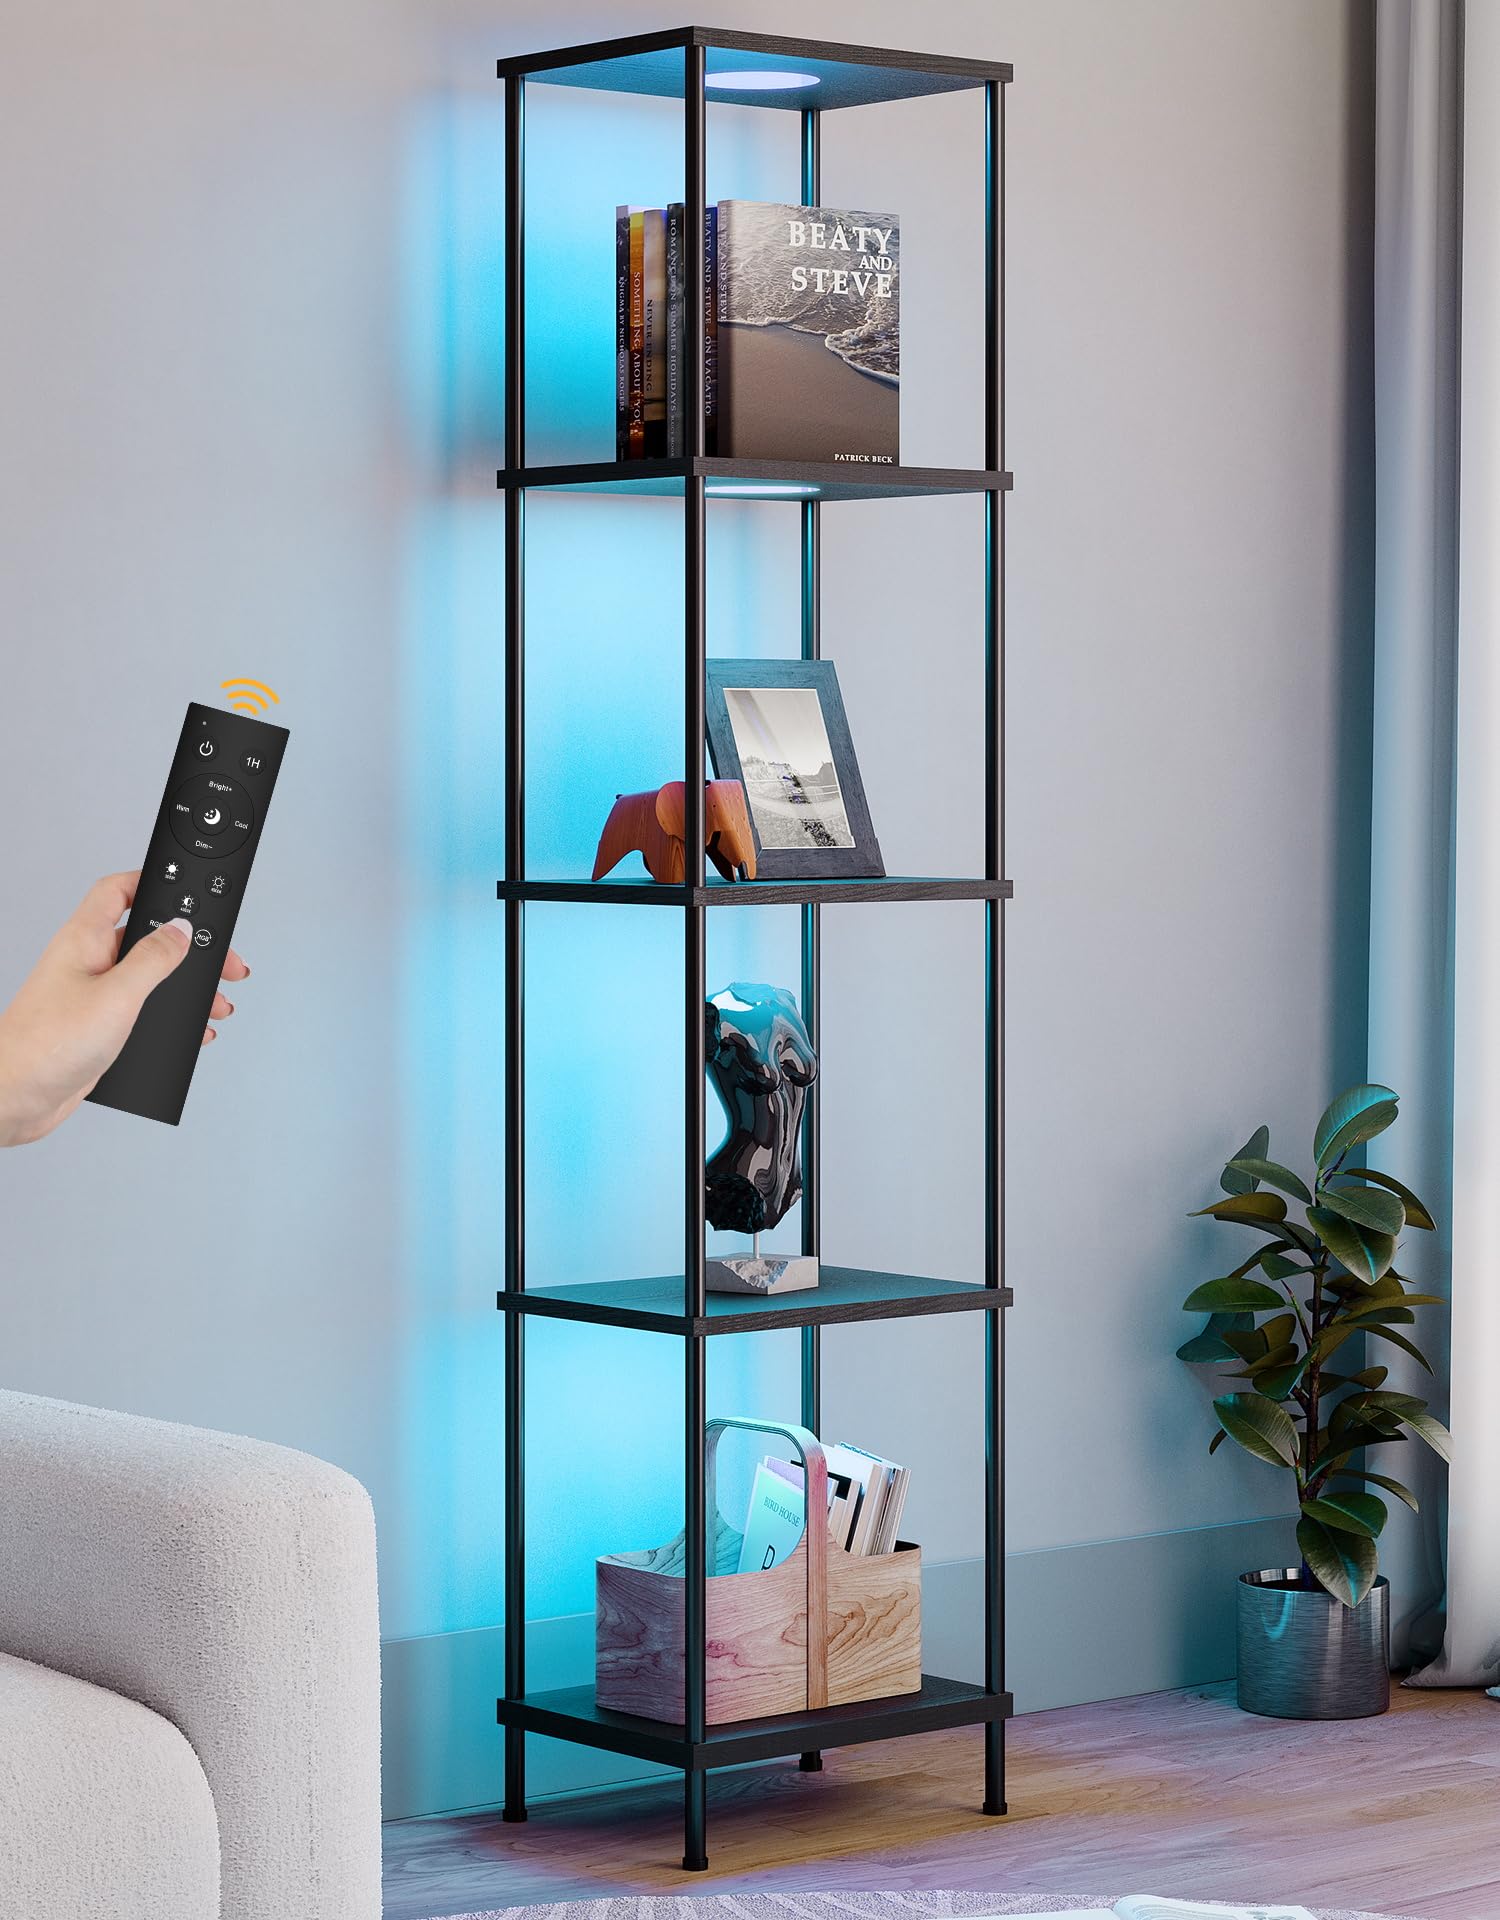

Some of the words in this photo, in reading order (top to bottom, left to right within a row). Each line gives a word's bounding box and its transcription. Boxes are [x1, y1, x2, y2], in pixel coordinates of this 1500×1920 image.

[704, 213, 712, 252] BEATY
[788, 221, 892, 254] BEATY
[704, 255, 712, 283] AND
[720, 248, 728, 281] AND
[858, 254, 892, 271] AND
[670, 282, 677, 301] ON
[791, 267, 892, 298] STEVE
[633, 271, 641, 347] SOMETHING
[704, 286, 712, 325] STEVE
[720, 284, 728, 322] STEVE
[704, 335, 712, 354] ON
[633, 352, 641, 394] ABOUT
[834, 453, 870, 463] PATRICK
[872, 454, 893, 464] BECK
[246, 756, 261, 769] 1H
[234, 820, 249, 830] Cool
[196, 932, 210, 943] RGB
[763, 1496, 779, 1515] BIRD
[779, 1507, 801, 1527] HOUSE
